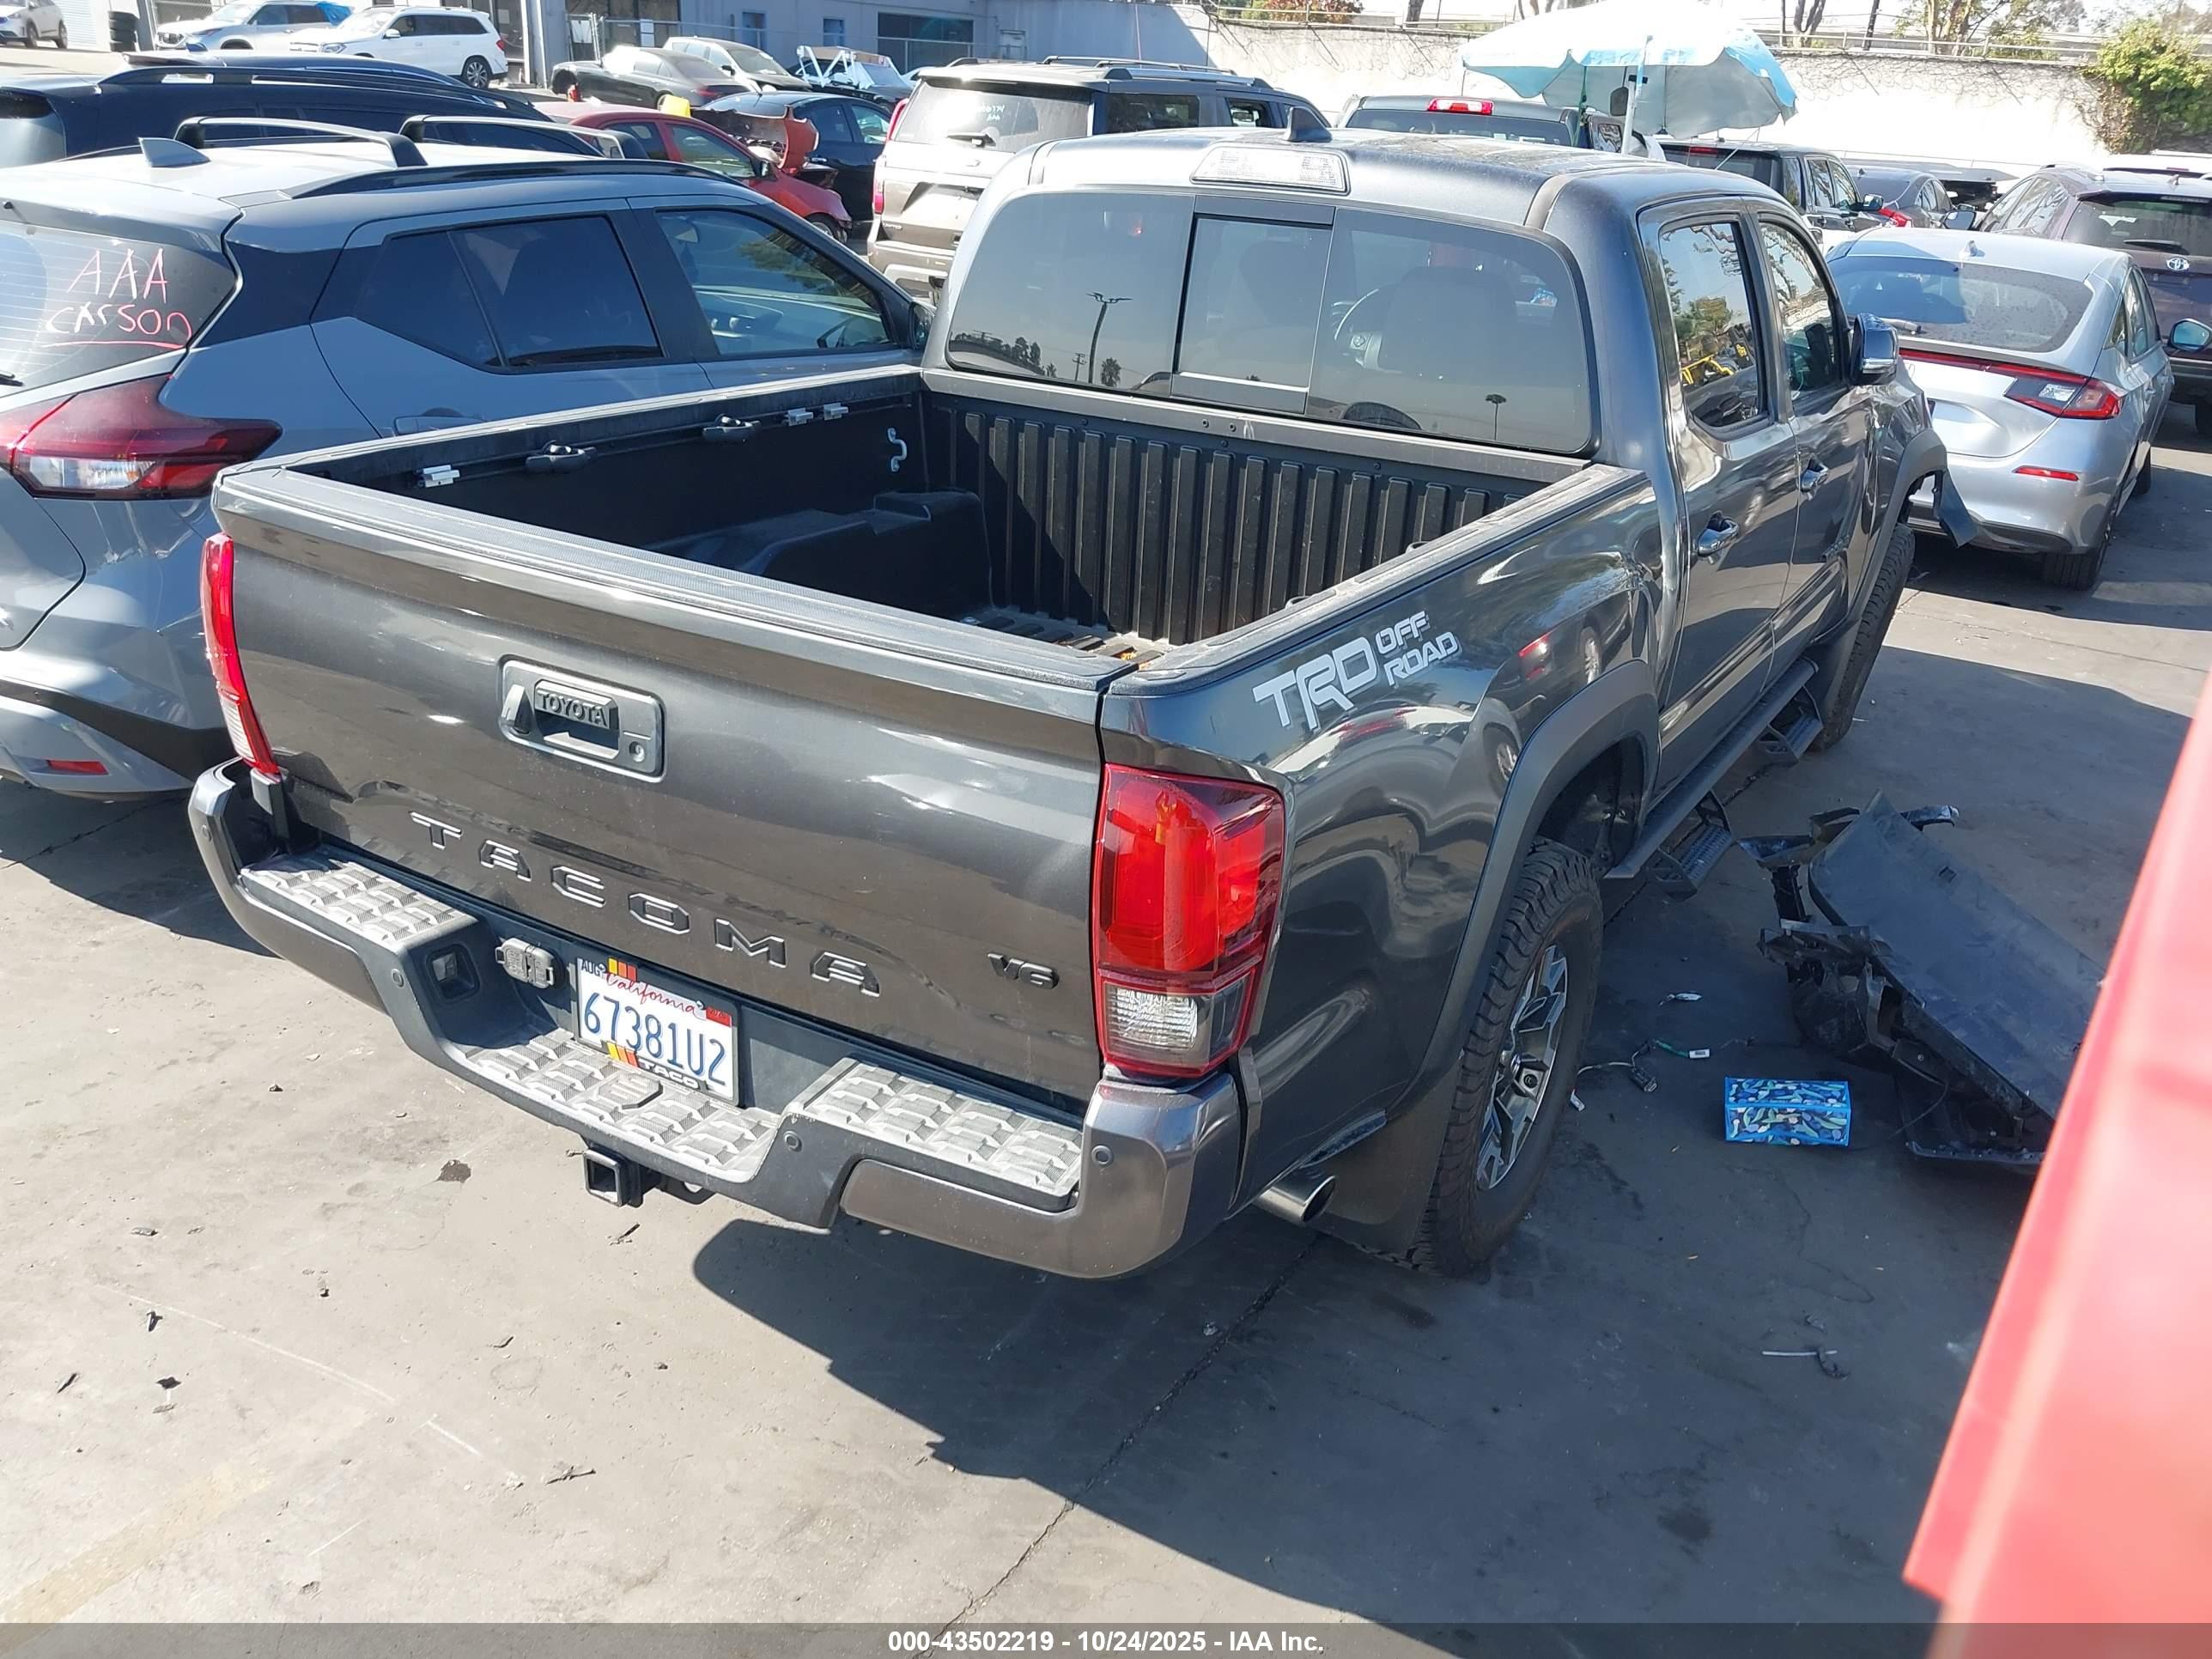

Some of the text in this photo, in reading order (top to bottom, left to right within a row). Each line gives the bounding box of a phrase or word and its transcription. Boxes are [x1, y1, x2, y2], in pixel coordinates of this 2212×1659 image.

[67, 248, 169, 304] AAA
[1375, 611, 1429, 655] OFF
[1383, 631, 1460, 686] ROAD
[1252, 636, 1377, 730] TRD
[537, 690, 608, 728] TOYOTA
[410, 811, 881, 998] TACOMA
[581, 959, 601, 977] AUG
[988, 952, 1060, 990] V6
[605, 972, 702, 1018] California
[584, 992, 726, 1086] 67381U2
[638, 1058, 699, 1090] TACO
